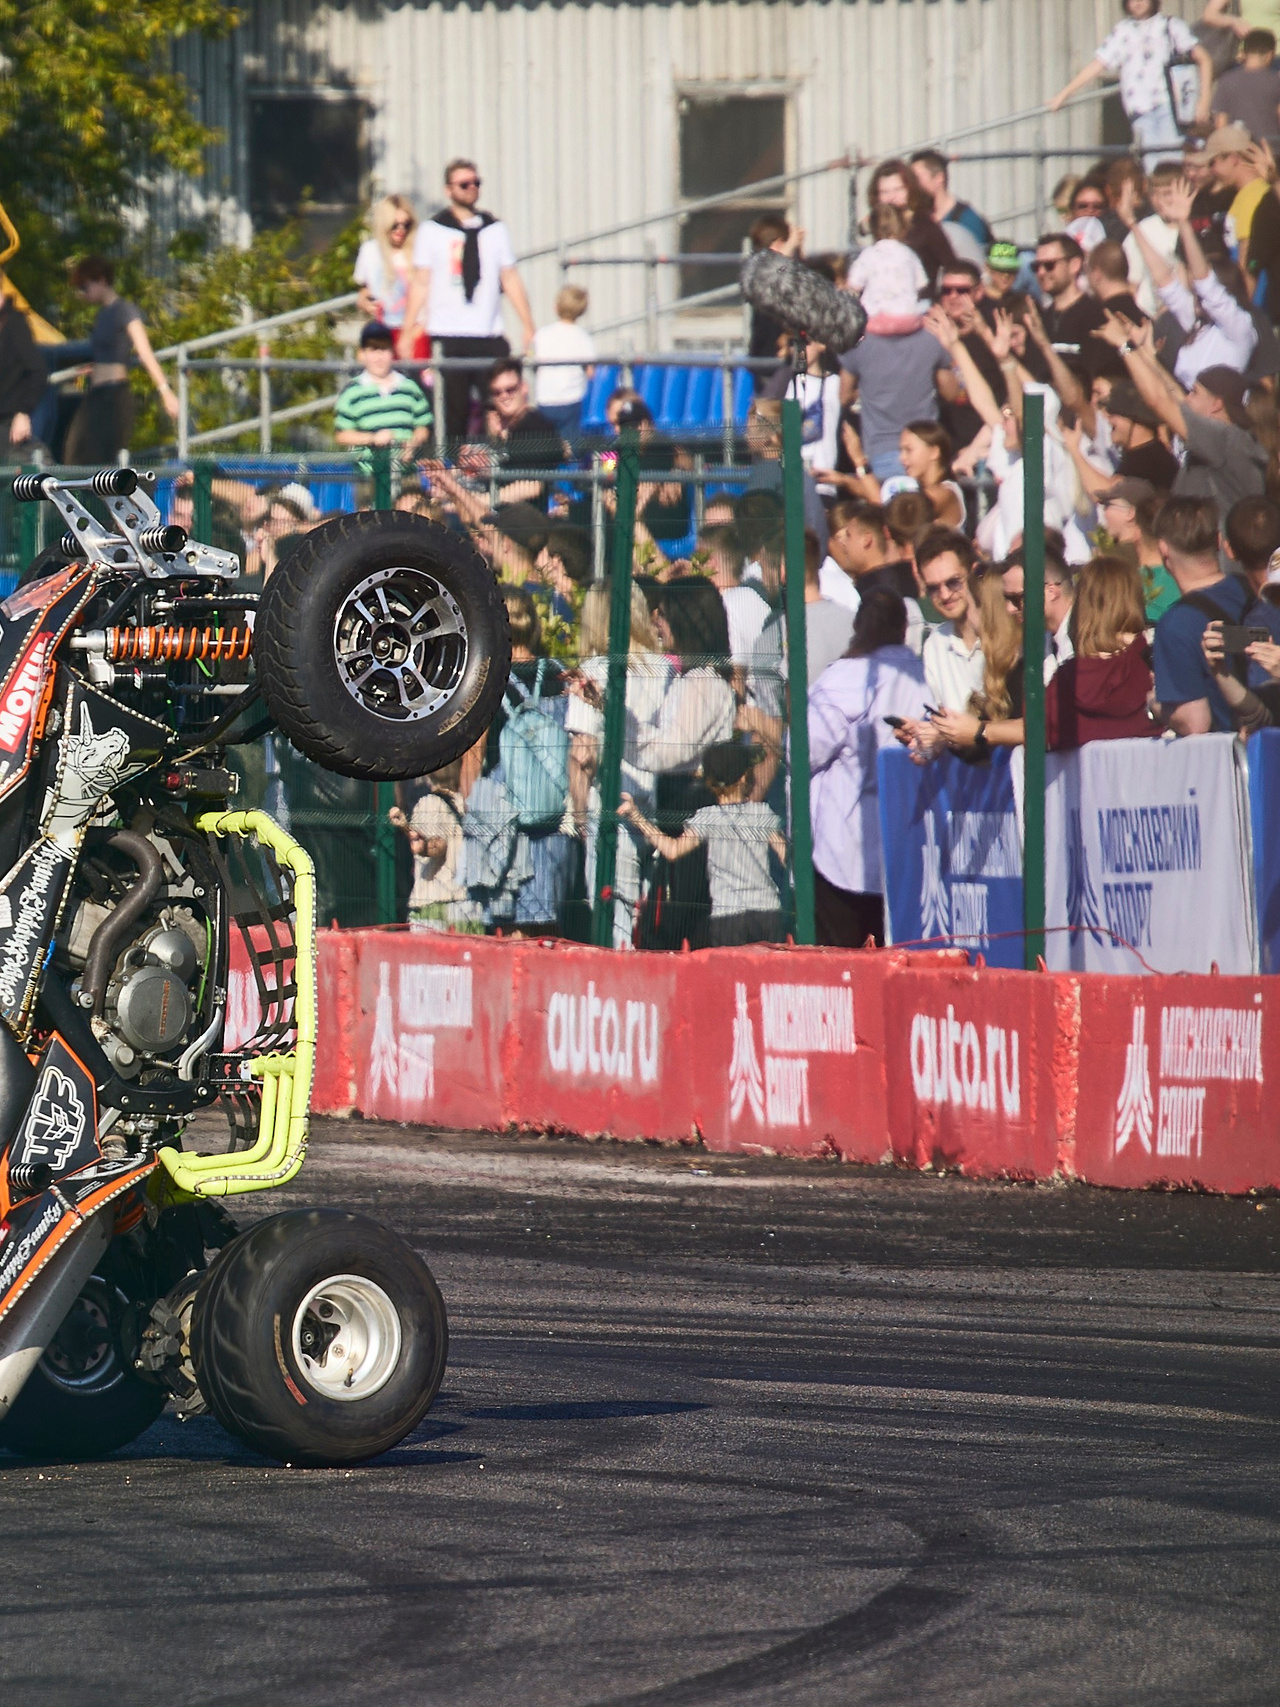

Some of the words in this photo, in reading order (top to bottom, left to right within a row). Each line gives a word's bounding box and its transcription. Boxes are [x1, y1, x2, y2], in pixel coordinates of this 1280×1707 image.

[1098, 787, 1202, 873] МОСКОВСКИЙ
[1103, 882, 1153, 947] СПОРТ
[546, 980, 659, 1083] auto.ru
[909, 1004, 1021, 1118] auto.ru
